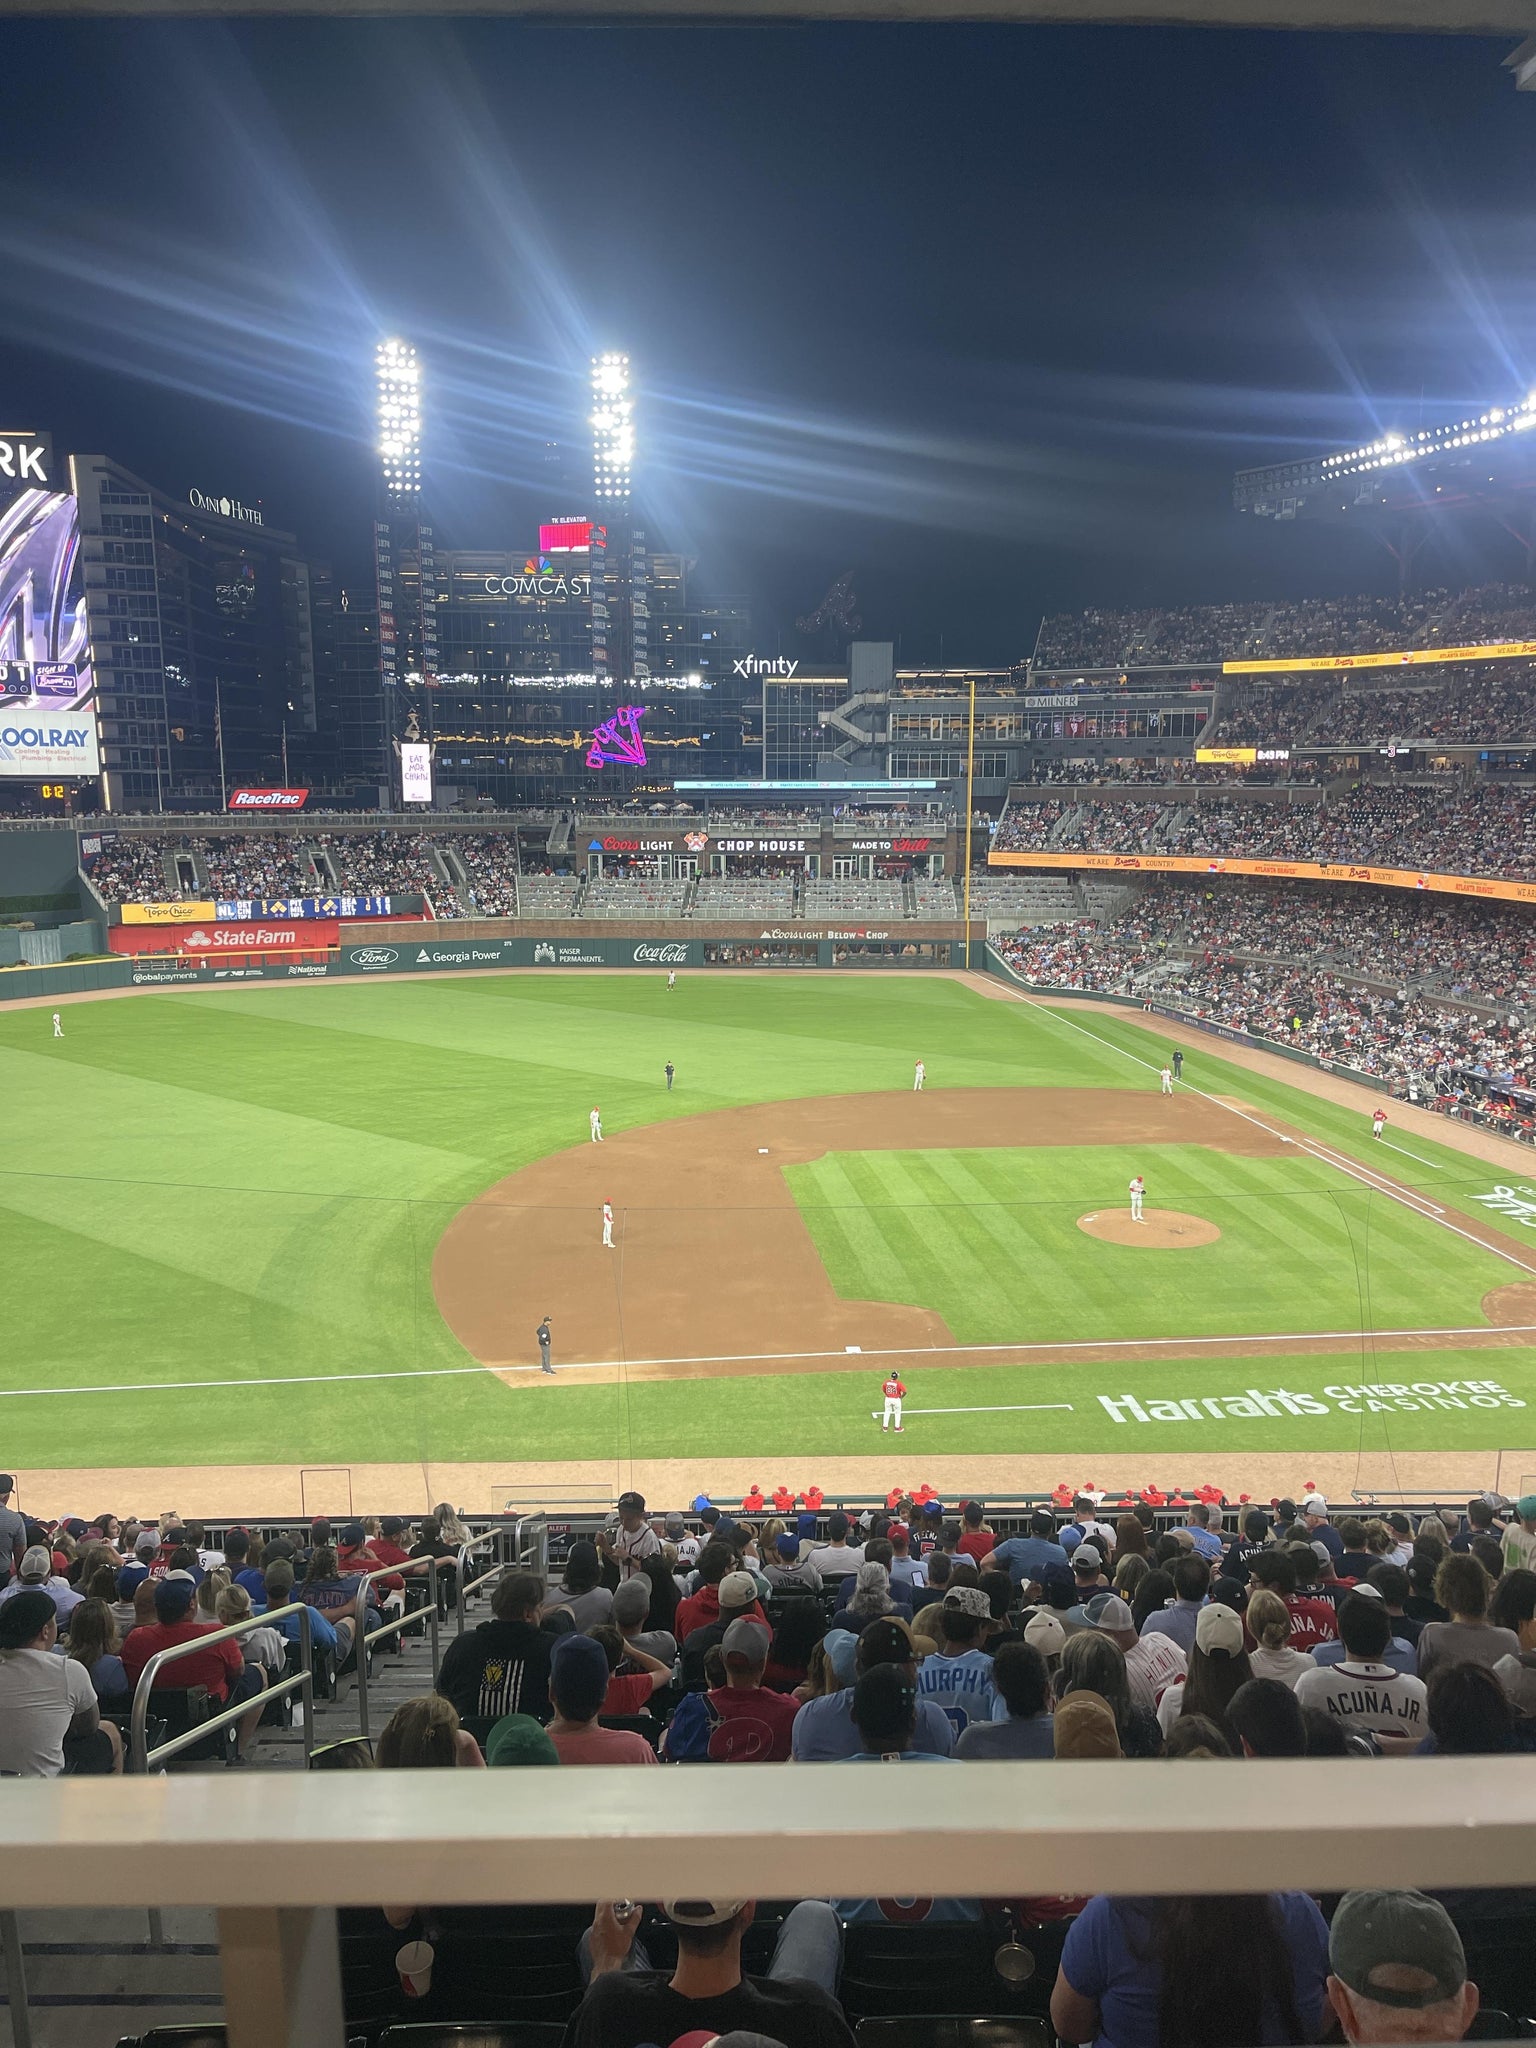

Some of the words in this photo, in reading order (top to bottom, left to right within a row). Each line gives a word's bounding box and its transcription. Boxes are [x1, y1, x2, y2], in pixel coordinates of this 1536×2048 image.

[485, 576, 591, 595] COMCAST
[733, 654, 799, 679] xfinity
[1037, 697, 1076, 707] MILNER
[409, 755, 423, 763] EAT
[1275, 751, 1289, 760] PM
[235, 793, 300, 805] RaceTrac
[603, 836, 639, 851] Coors
[641, 841, 673, 851] LIGHT
[717, 840, 754, 851] CHOP
[759, 840, 806, 851] HOUSE
[852, 841, 878, 850] MADE
[879, 841, 892, 850] TO
[144, 905, 169, 917] Topo
[169, 905, 194, 917] Chico
[218, 905, 234, 916] NL
[772, 929, 799, 939] Coors
[828, 931, 856, 939] BELOW
[866, 931, 888, 939] CHOP
[359, 951, 390, 963] Ford
[432, 952, 470, 963] Georgia
[472, 951, 501, 960] Power
[1323, 1380, 1508, 1400] CHEROKEE
[1338, 1394, 1527, 1413] CASINOS
[1327, 1685, 1393, 1716] ACUÑA
